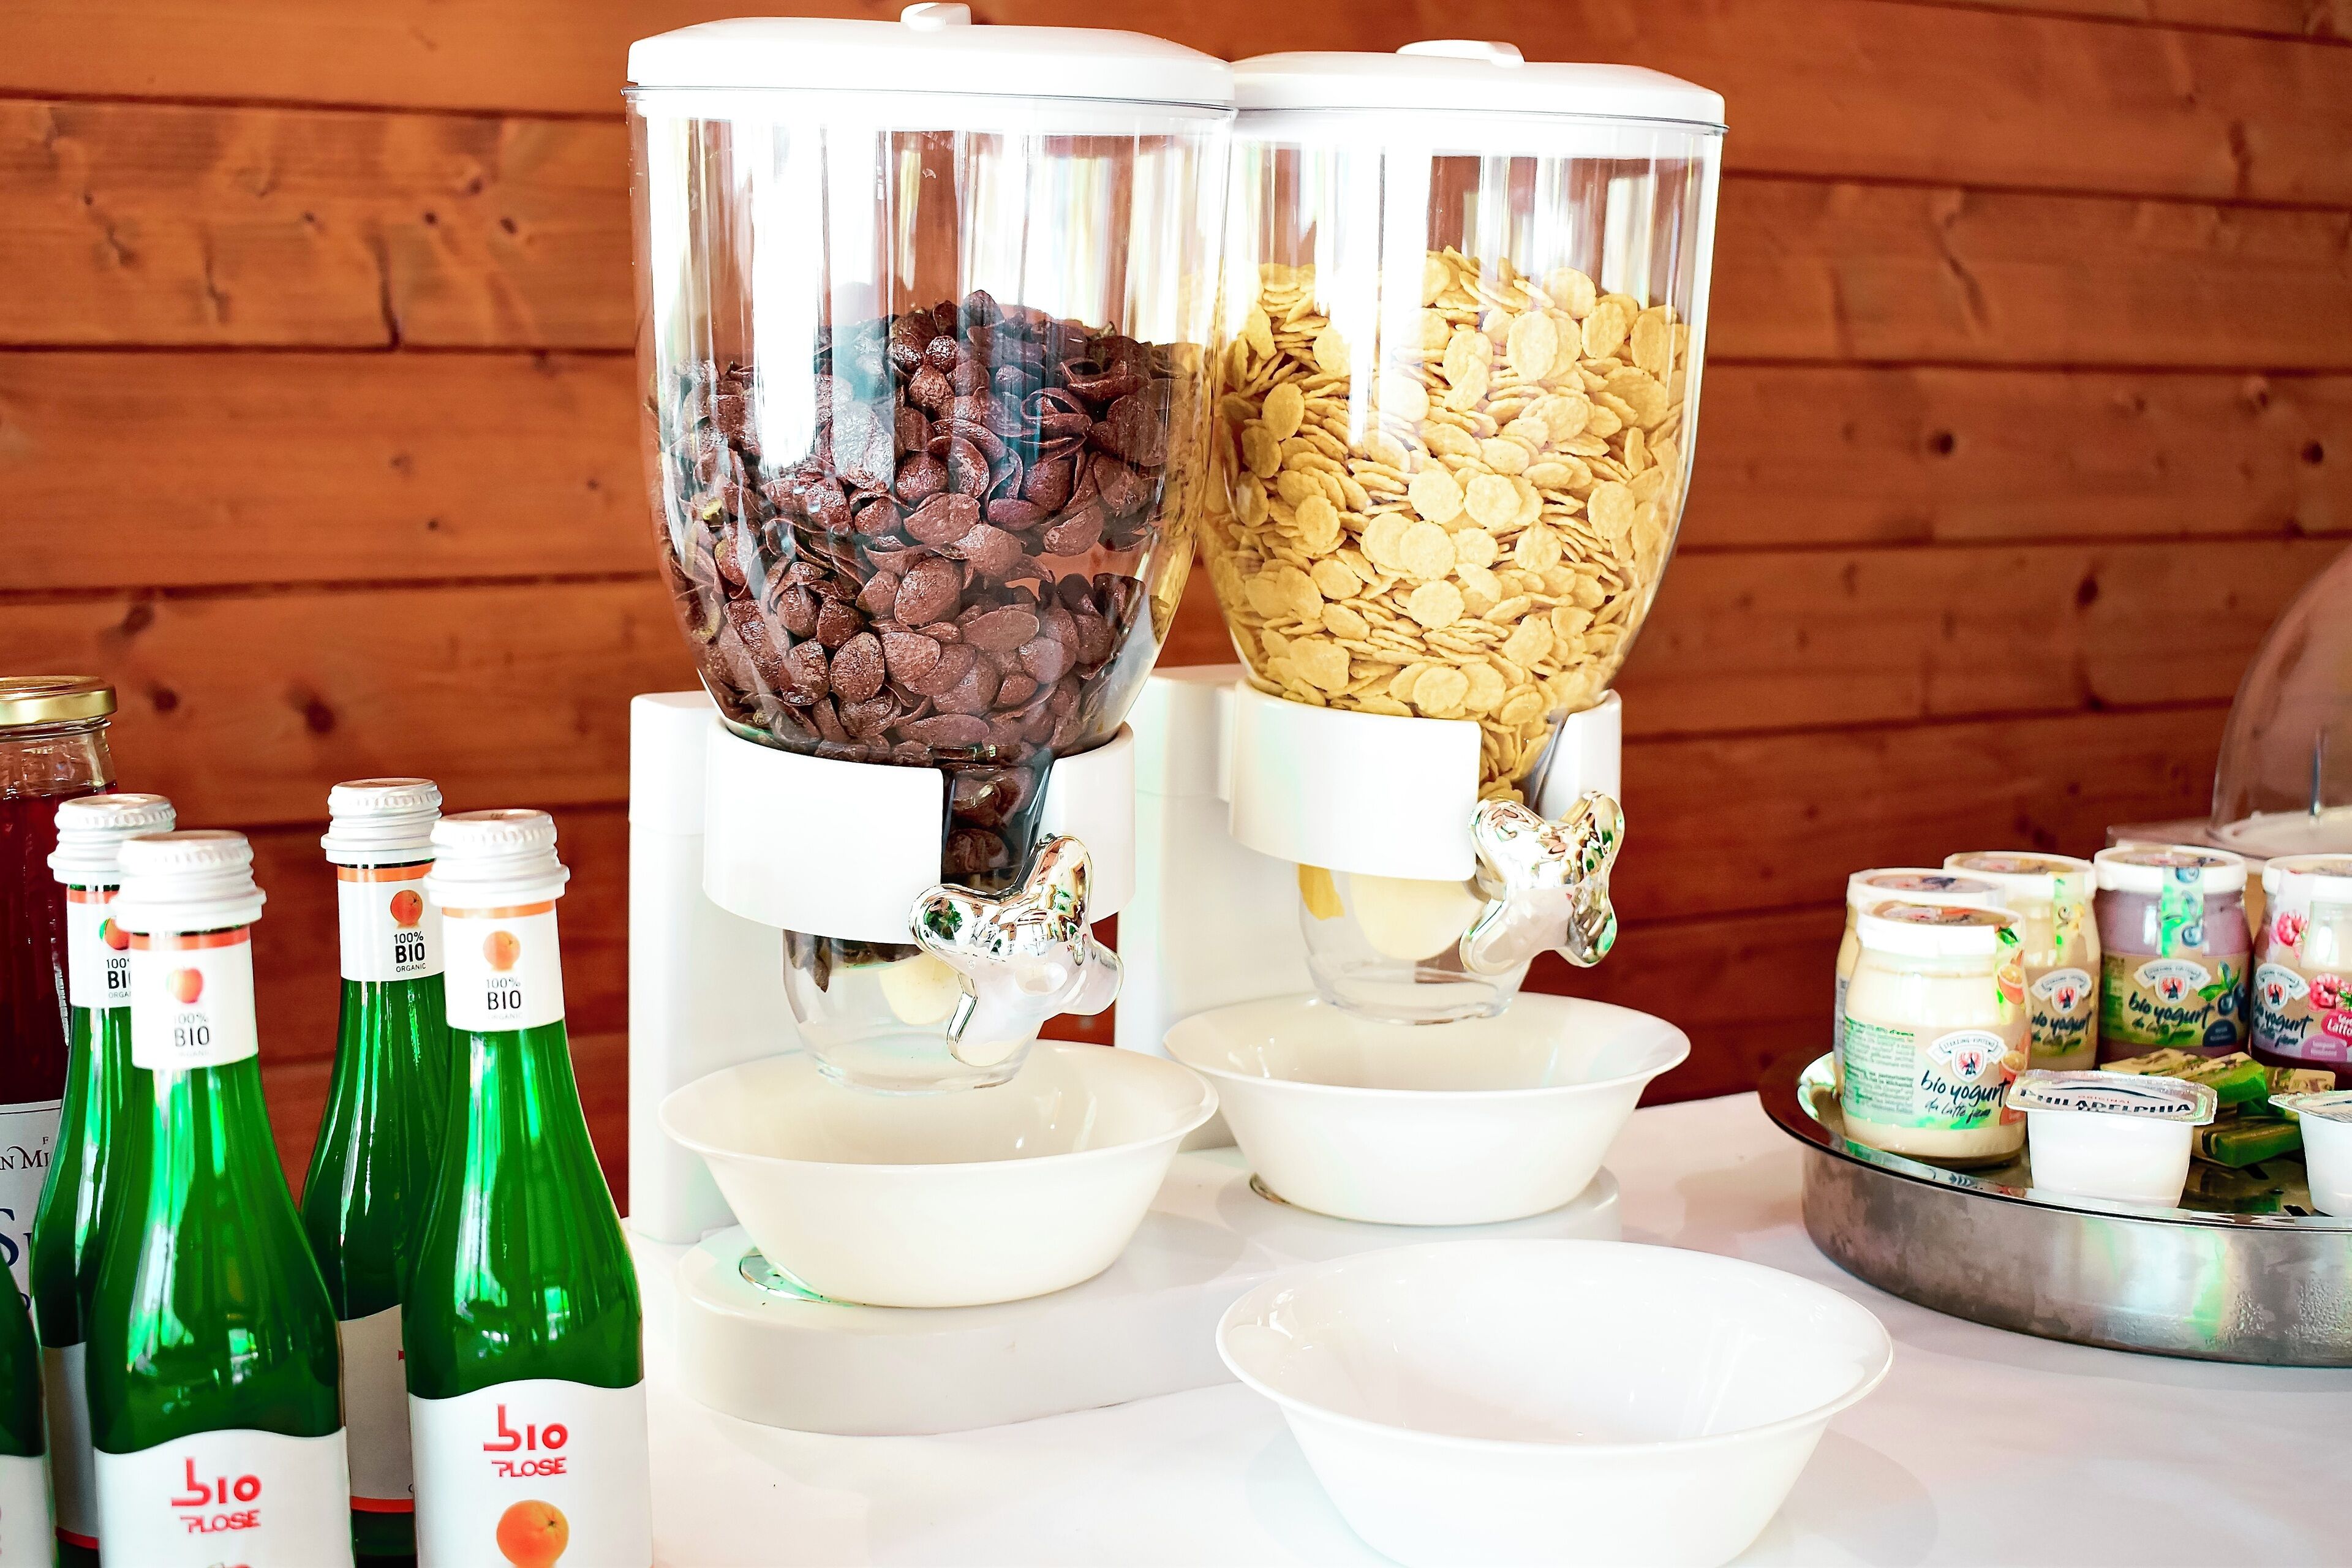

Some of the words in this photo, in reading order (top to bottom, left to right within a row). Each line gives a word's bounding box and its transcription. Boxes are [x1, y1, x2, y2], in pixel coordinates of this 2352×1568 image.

[394, 931, 424, 944] 100%
[107, 958, 130, 968] 100
[395, 943, 425, 963] BIO
[396, 963, 426, 973] ORGANIC
[108, 970, 131, 989] BI
[486, 977, 521, 989] 100%
[488, 990, 521, 1010] BIO
[2128, 990, 2152, 1014] bio
[2154, 1003, 2215, 1030] yogurt
[2265, 1010, 2314, 1039] yogurt
[175, 1026, 209, 1047] BIO
[1921, 1069, 1946, 1095] bio
[1950, 1078, 2011, 1107] yogurt
[483, 1403, 568, 1452] bio
[491, 1456, 567, 1477] PLOSE
[171, 1457, 262, 1507] bio
[180, 1509, 262, 1533] PLOSE
